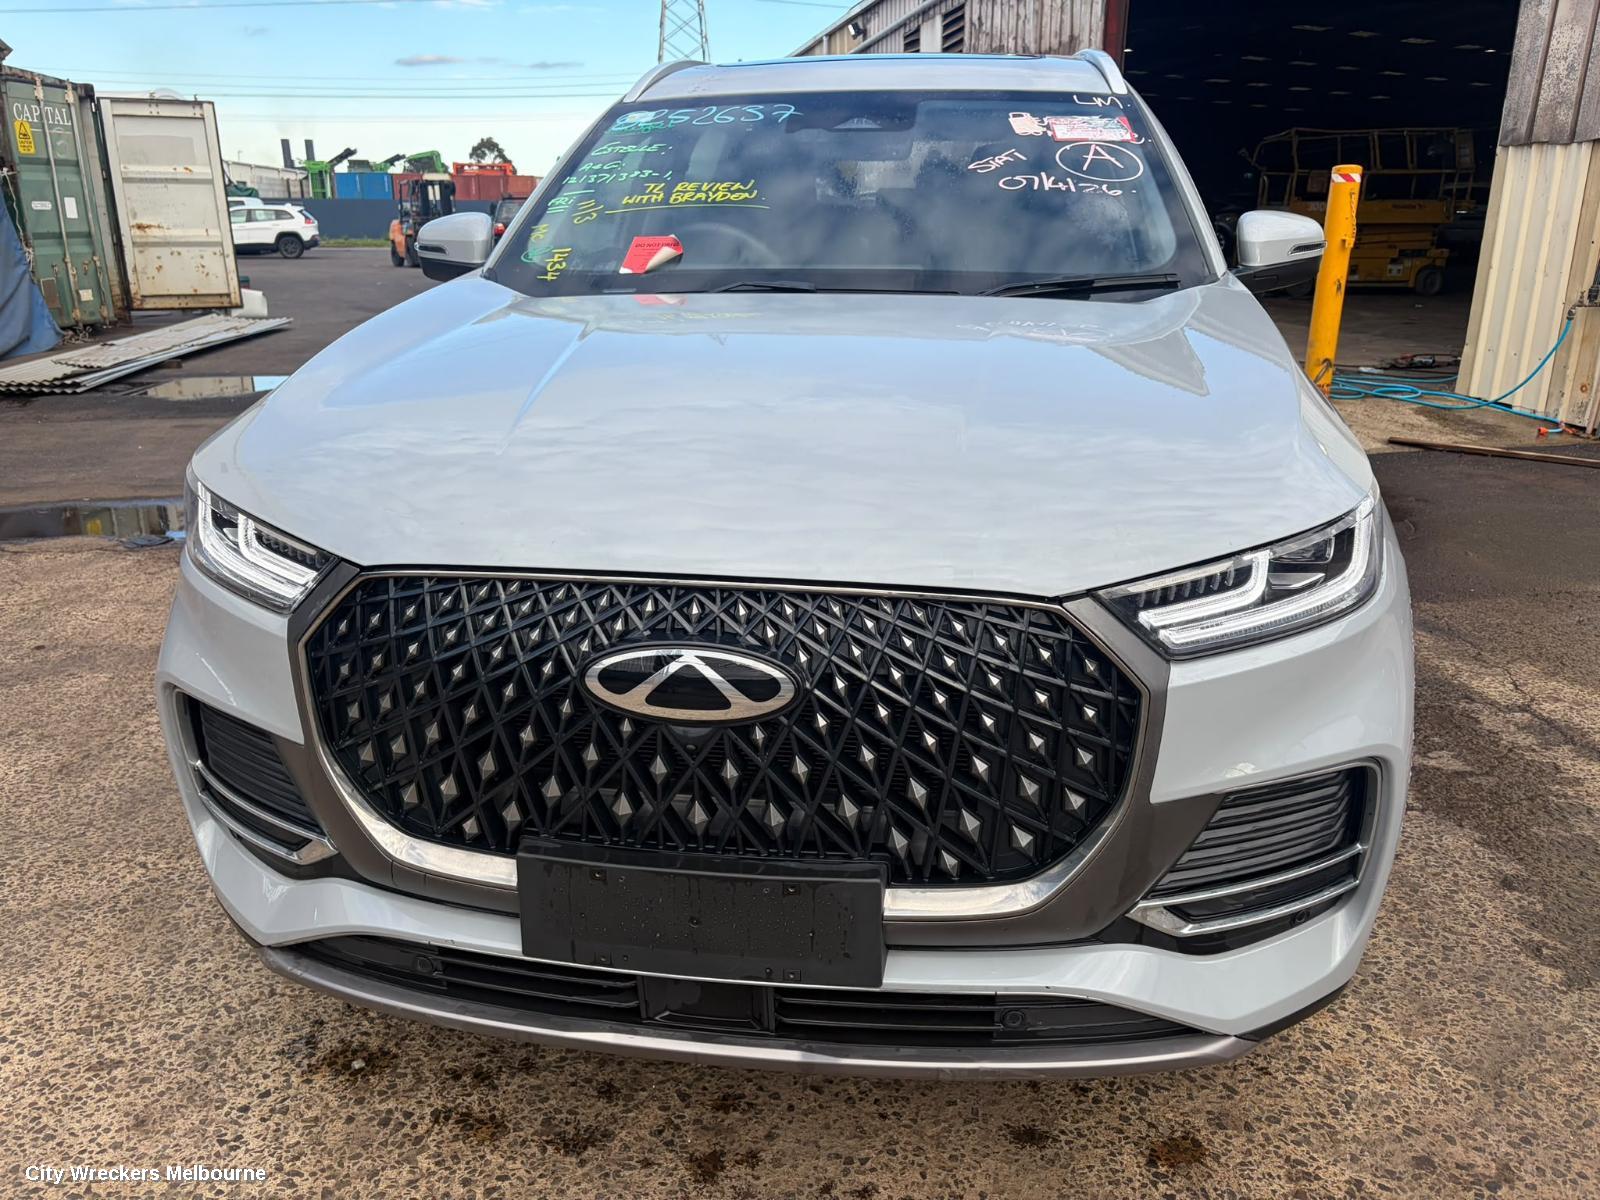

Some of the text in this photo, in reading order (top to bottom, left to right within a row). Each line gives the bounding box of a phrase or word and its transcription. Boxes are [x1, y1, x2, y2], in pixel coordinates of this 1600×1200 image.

[13, 102, 72, 126] CAPTAL
[672, 179, 755, 193] REVIEW
[622, 192, 665, 205] WITH
